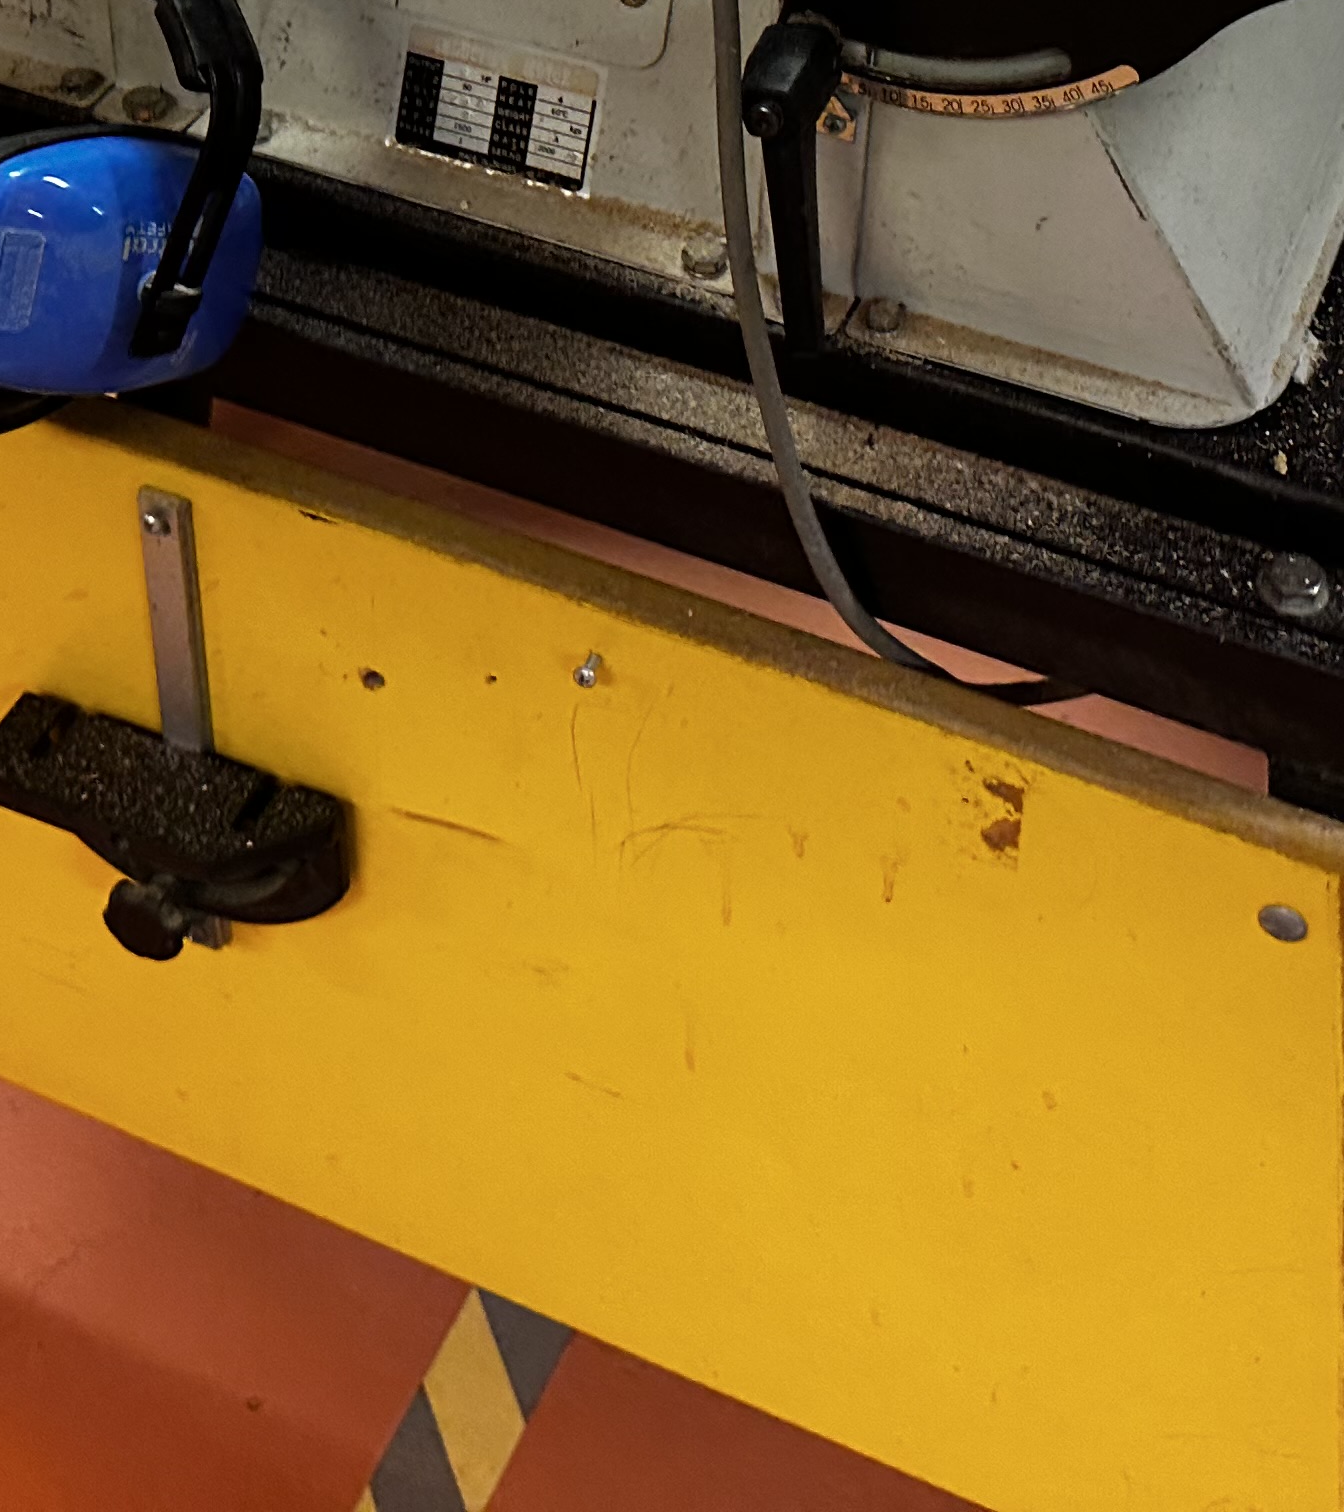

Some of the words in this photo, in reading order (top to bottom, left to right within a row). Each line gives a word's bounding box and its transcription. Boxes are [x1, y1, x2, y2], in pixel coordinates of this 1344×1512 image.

[882, 88, 899, 103] 10
[912, 94, 929, 109] 15
[942, 98, 960, 112] 20
[971, 100, 990, 114] 25
[1002, 98, 1021, 113] 30
[1032, 95, 1051, 111] 35
[1063, 88, 1080, 103] 40
[1091, 79, 1110, 95] 45
